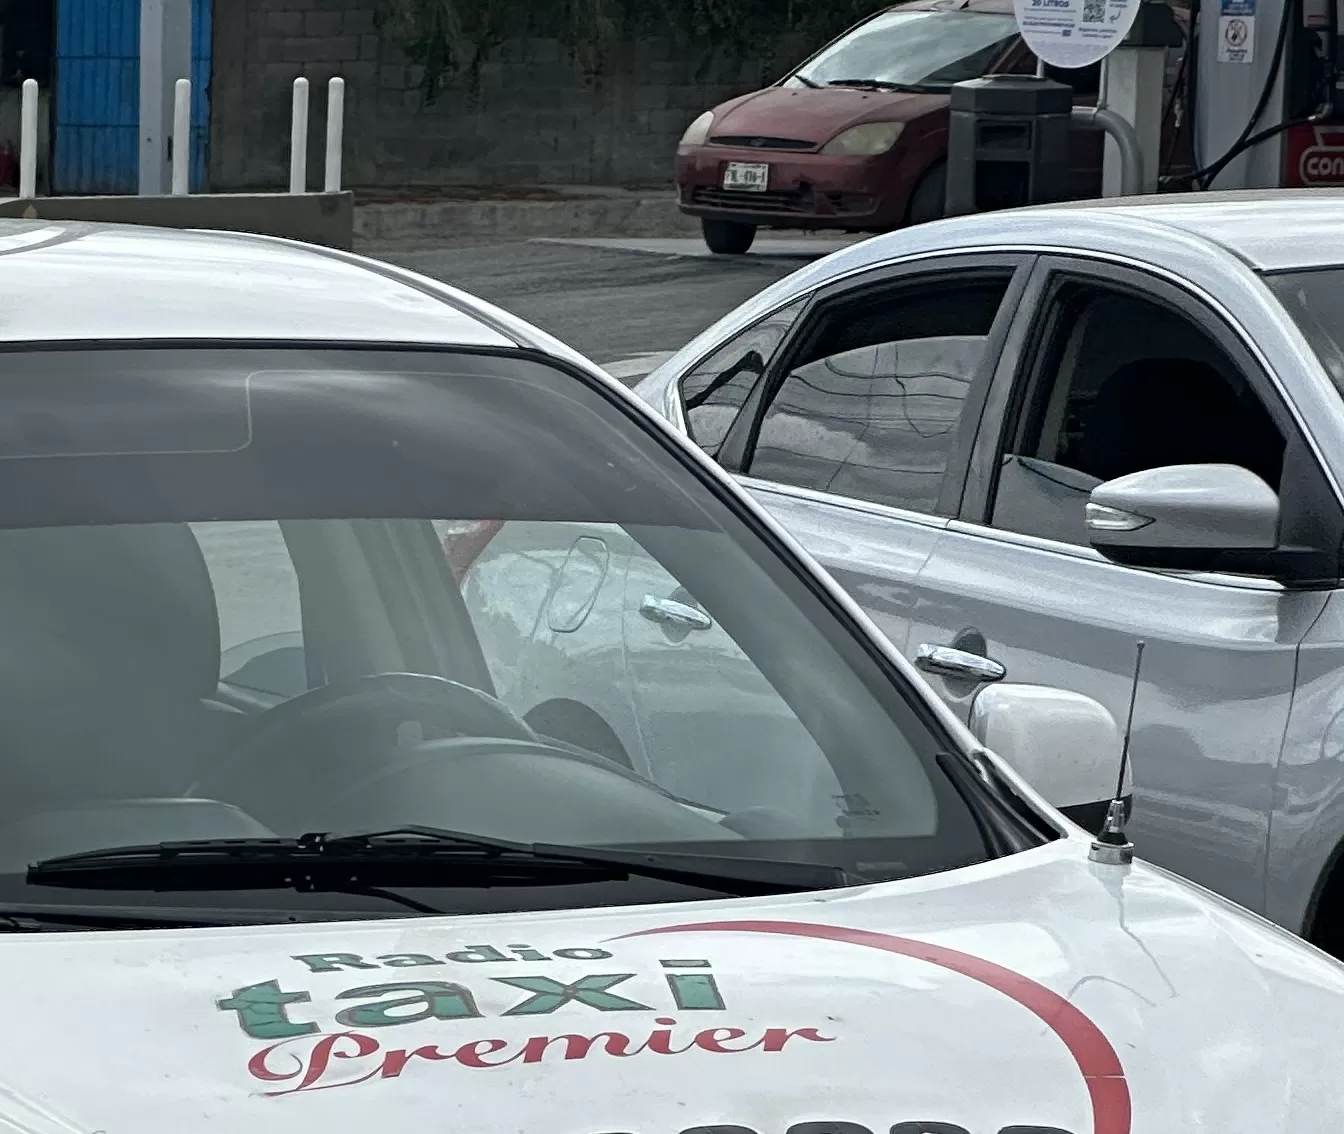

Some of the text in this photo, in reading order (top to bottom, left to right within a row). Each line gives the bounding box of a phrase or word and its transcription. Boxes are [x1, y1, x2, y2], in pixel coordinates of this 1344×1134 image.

[216, 958, 727, 1039] taxi
[290, 943, 615, 973] Radio
[247, 1016, 837, 1098] Premier
